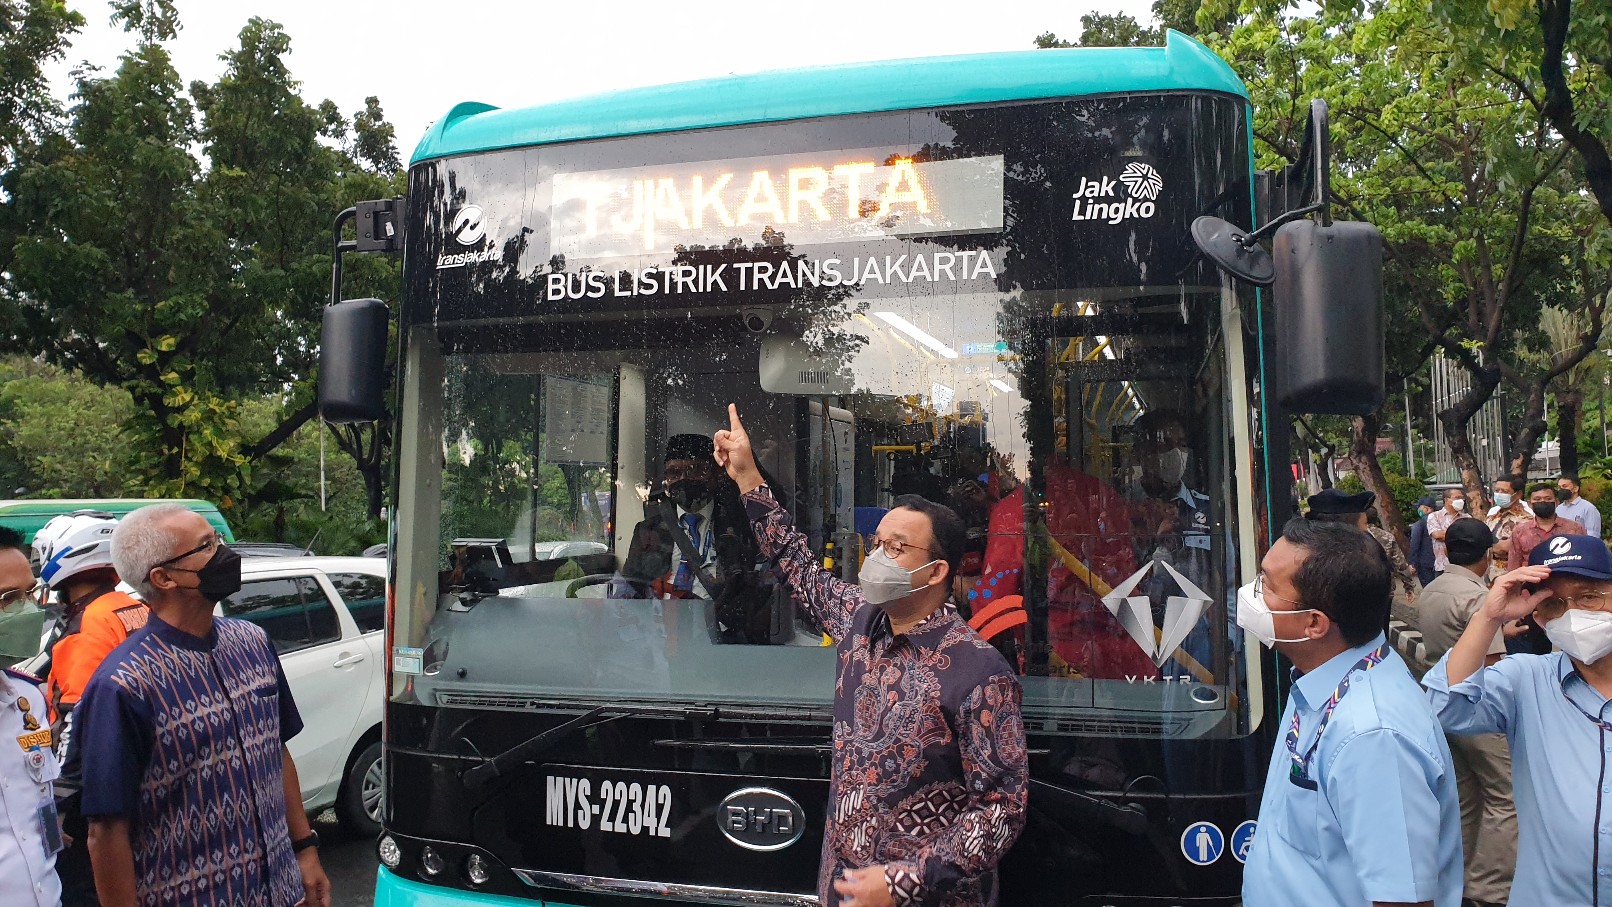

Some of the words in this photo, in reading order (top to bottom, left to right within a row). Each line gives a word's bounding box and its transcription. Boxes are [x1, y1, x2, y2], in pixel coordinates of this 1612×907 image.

[1072, 175, 1115, 199] Jak
[1072, 197, 1155, 224] Lingko
[436, 248, 502, 269] transjakarta
[547, 270, 606, 301] BUS
[614, 263, 728, 296] LISTRIK
[733, 250, 997, 291] TRANSJAKARTA
[1124, 674, 1192, 686] VKTR
[546, 775, 672, 838] MYS-22342
[726, 805, 793, 835] BYD
